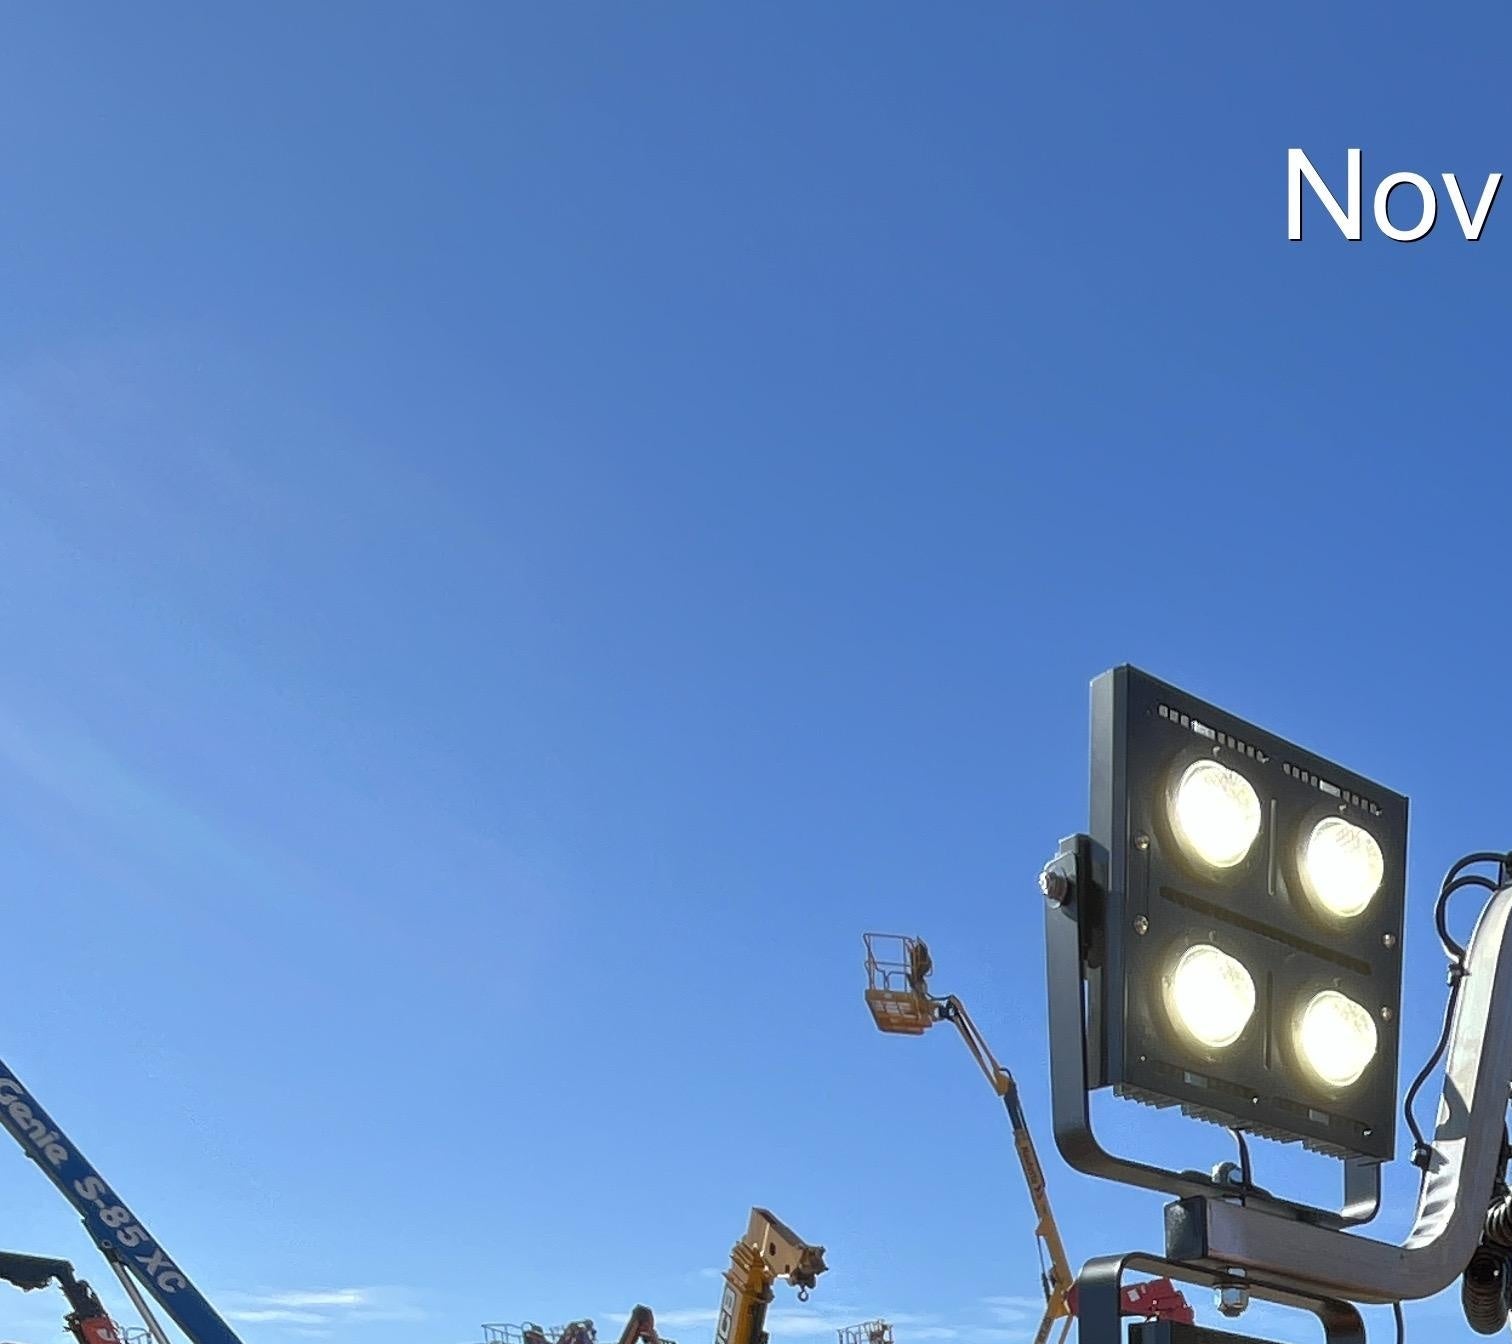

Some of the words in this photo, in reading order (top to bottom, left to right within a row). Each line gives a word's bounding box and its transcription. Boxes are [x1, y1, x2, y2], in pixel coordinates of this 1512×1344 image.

[0, 1077, 68, 1165] Genie
[74, 1175, 149, 1248] S-85
[135, 1249, 187, 1293] XC
